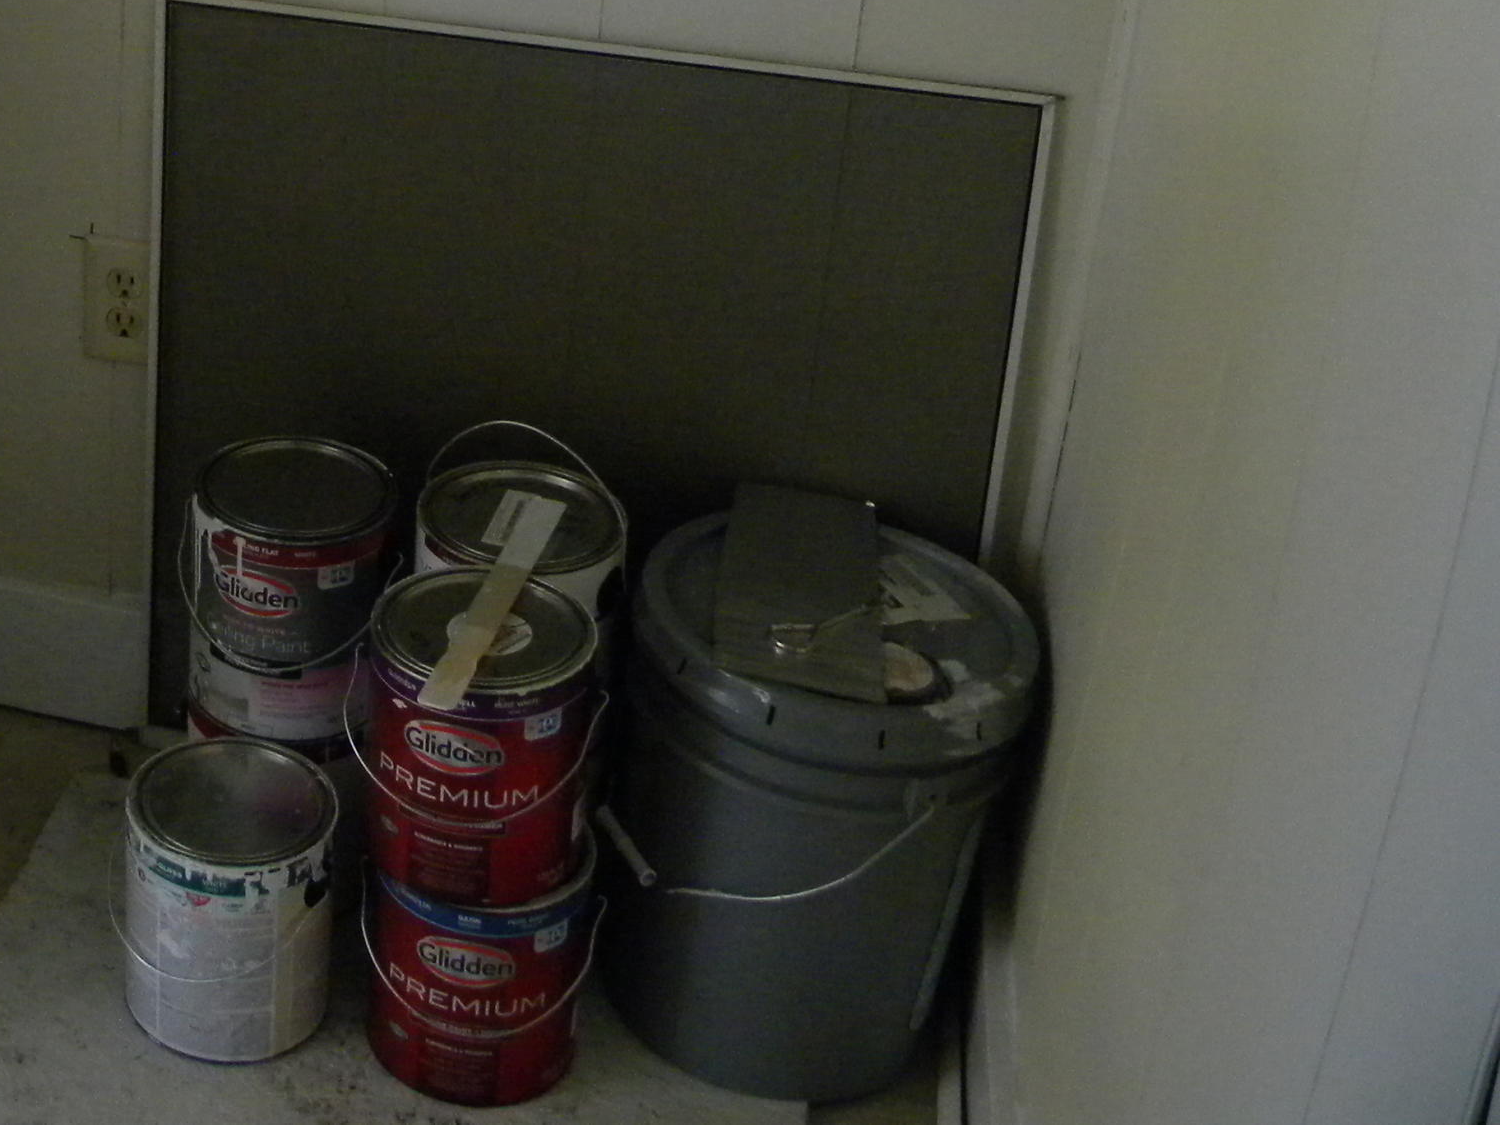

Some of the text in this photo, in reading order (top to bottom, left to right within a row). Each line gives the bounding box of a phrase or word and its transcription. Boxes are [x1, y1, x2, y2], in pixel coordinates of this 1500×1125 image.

[404, 725, 502, 766] Glidden
[379, 750, 540, 810] PREMIUM
[418, 942, 513, 977] Glidden
[389, 961, 547, 1017] PREMIUM
